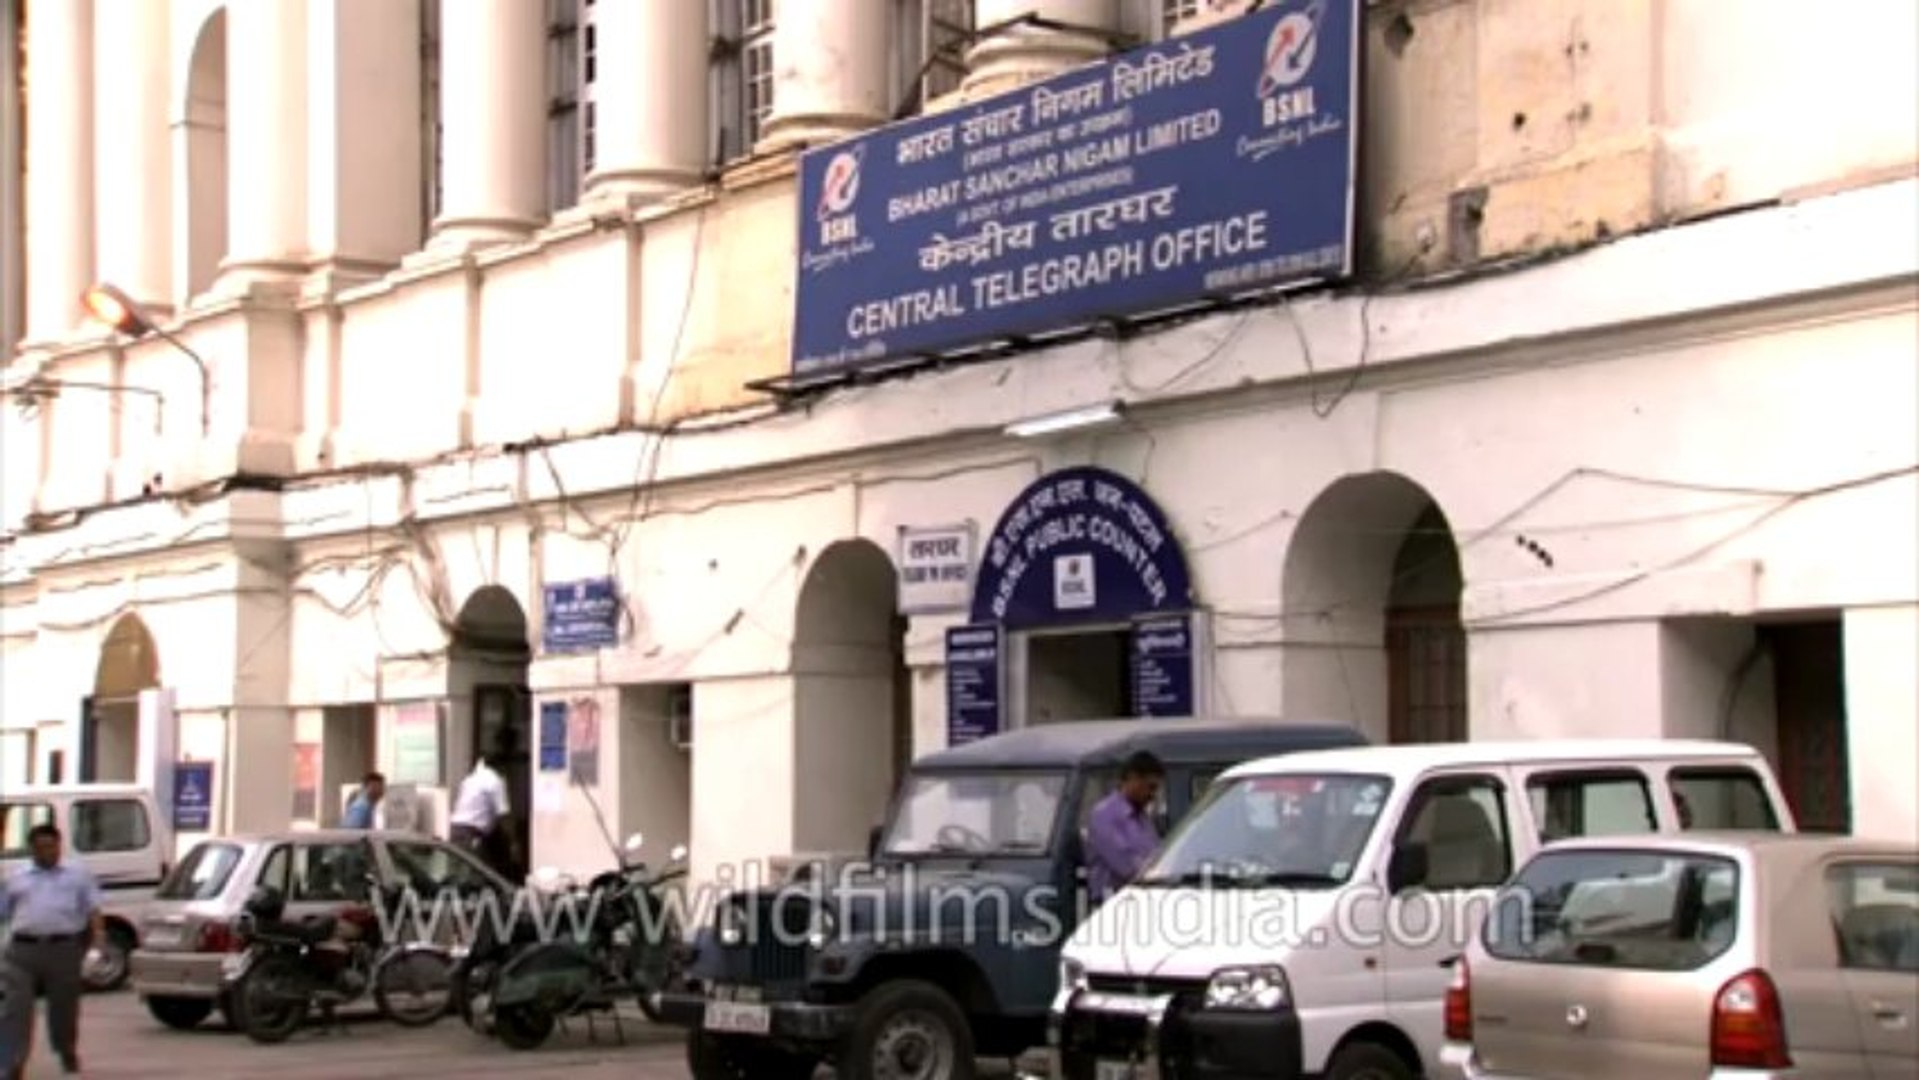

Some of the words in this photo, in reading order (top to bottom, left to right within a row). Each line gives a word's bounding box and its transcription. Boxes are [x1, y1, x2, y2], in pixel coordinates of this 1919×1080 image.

[896, 129, 953, 165] भारत
[961, 106, 1025, 145] संचार
[1032, 81, 1103, 125] निगम
[1112, 44, 1215, 101] लिमिटेड
[1262, 87, 1316, 127] BSNL
[888, 180, 960, 222] BHARAT
[964, 152, 1058, 200] SANCHAR
[1062, 134, 1130, 173] NIGAM
[1136, 109, 1221, 154] LIMITED
[1050, 184, 1179, 238] तारघर
[846, 284, 965, 339] CENTRAL
[970, 237, 1144, 309] TELEGRAPH
[1151, 209, 1268, 270] OFFICE
[1025, 513, 1085, 558] PUBLIC
[1089, 515, 1167, 606] COUNTER
